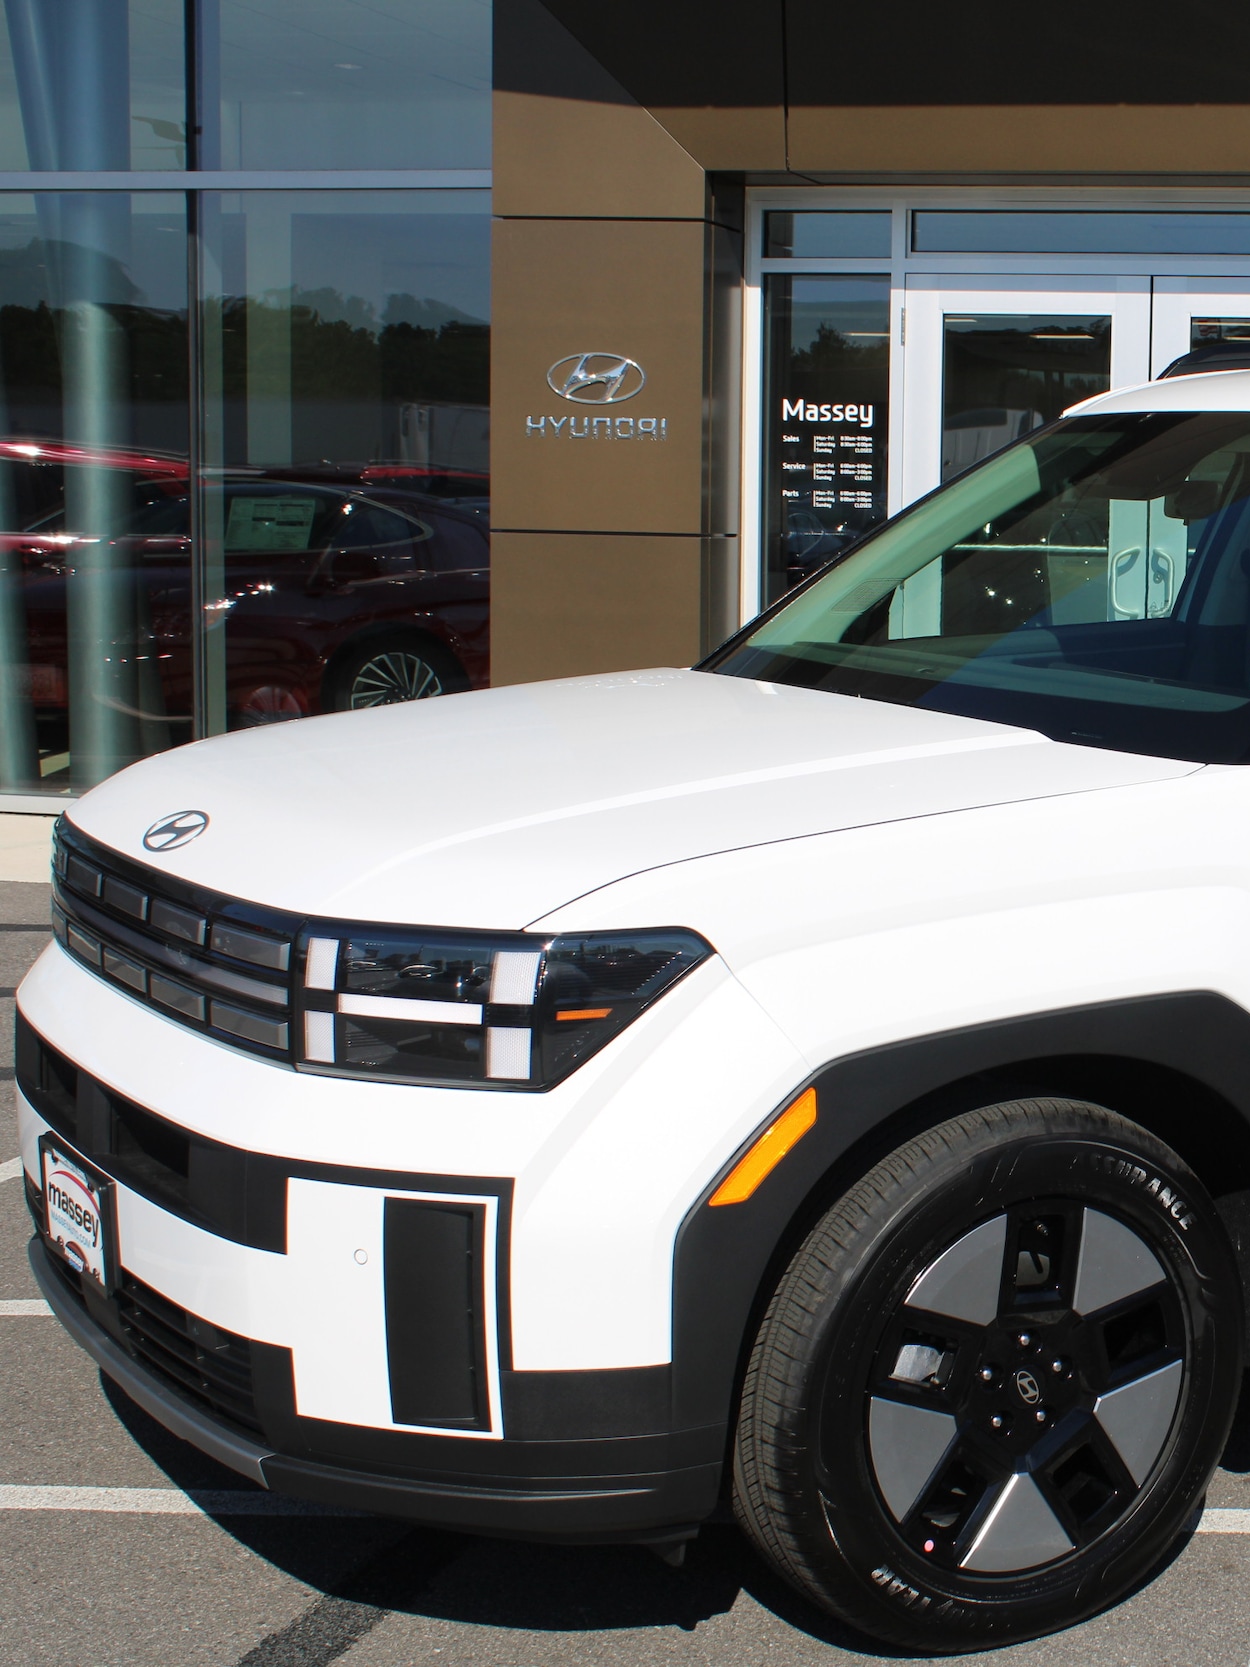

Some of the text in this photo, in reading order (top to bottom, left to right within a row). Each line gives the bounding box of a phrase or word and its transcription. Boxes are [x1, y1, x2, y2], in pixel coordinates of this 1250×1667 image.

[525, 414, 667, 440] HYUNDAI
[782, 398, 874, 428] Massey
[782, 462, 806, 470] Service
[48, 1181, 99, 1248] massey
